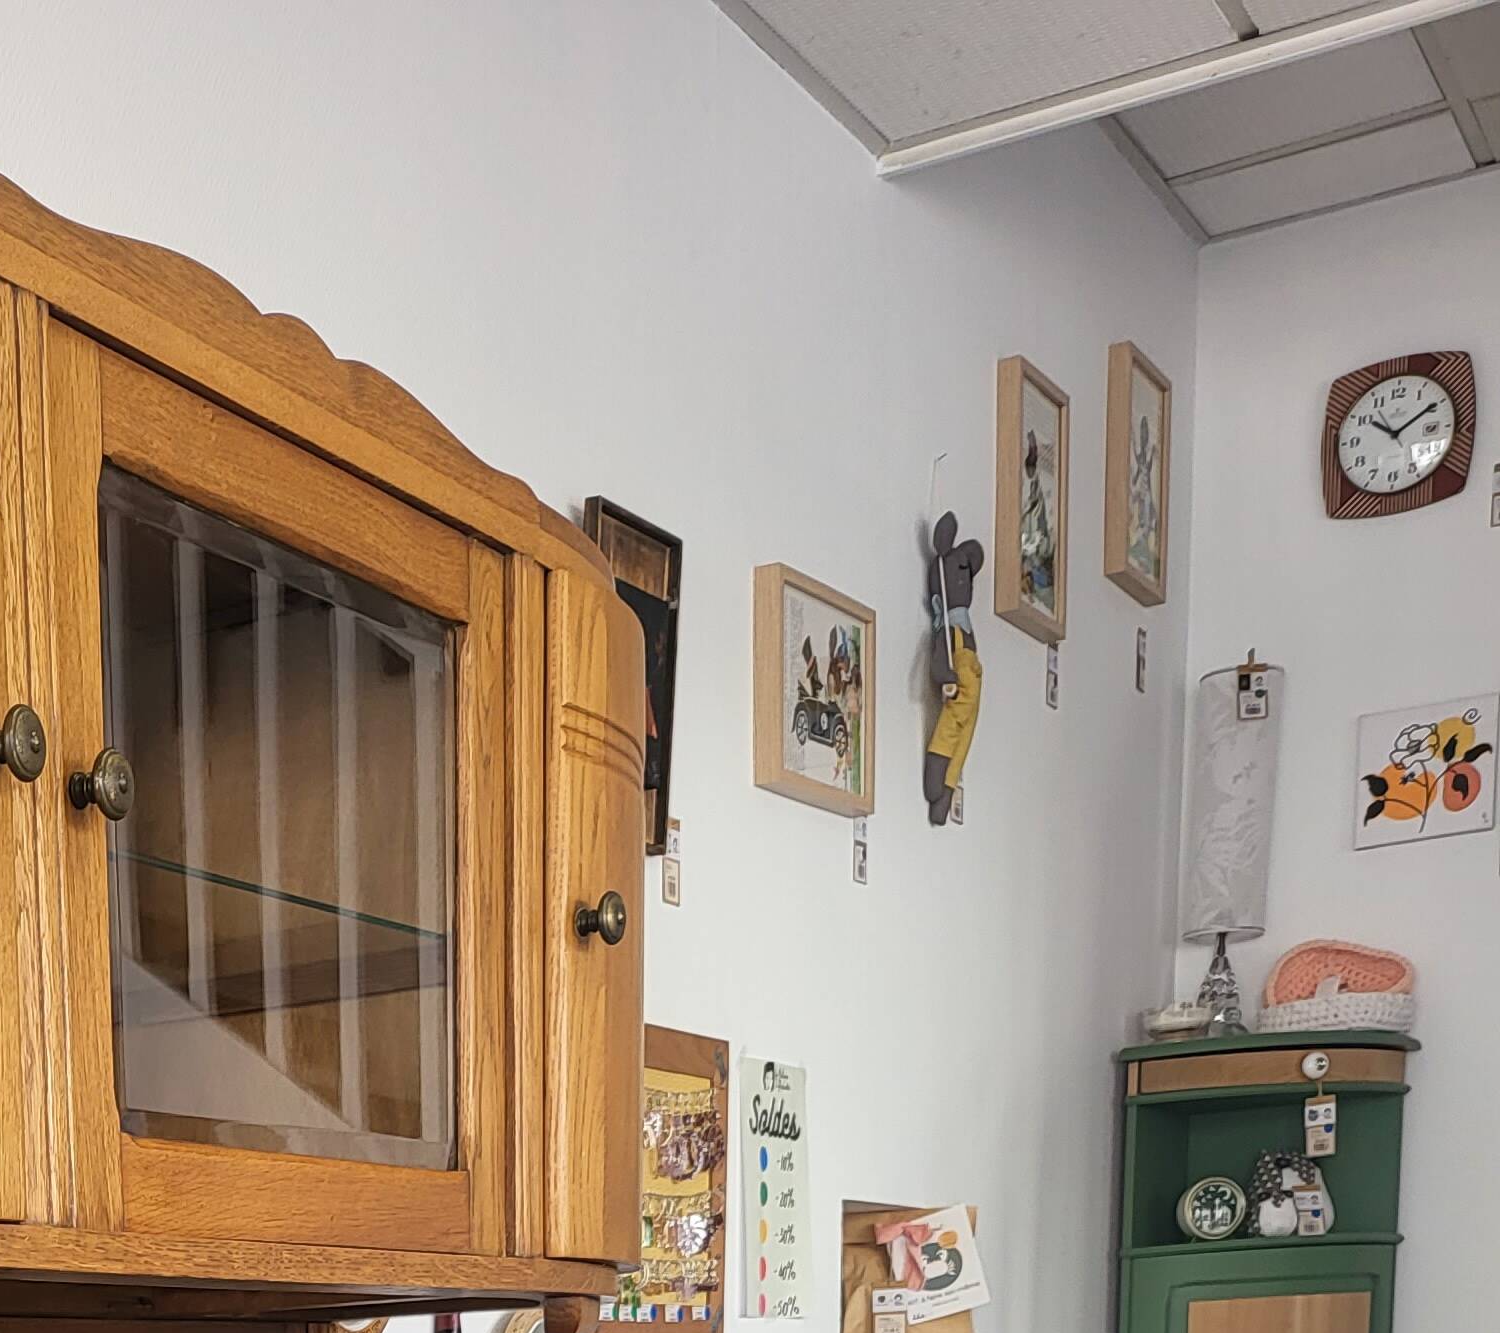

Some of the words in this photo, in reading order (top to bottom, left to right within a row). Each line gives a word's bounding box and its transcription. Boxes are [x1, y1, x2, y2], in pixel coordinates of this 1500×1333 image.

[1390, 387, 1407, 400] 12
[1373, 396, 1385, 408] 11
[1357, 414, 1373, 426] 10
[1349, 436, 1361, 448] 9
[1354, 456, 1366, 467] 8
[1368, 468, 1379, 480] 7
[749, 1094, 801, 1141] Soldes
[773, 1296, 799, 1316] -50%
